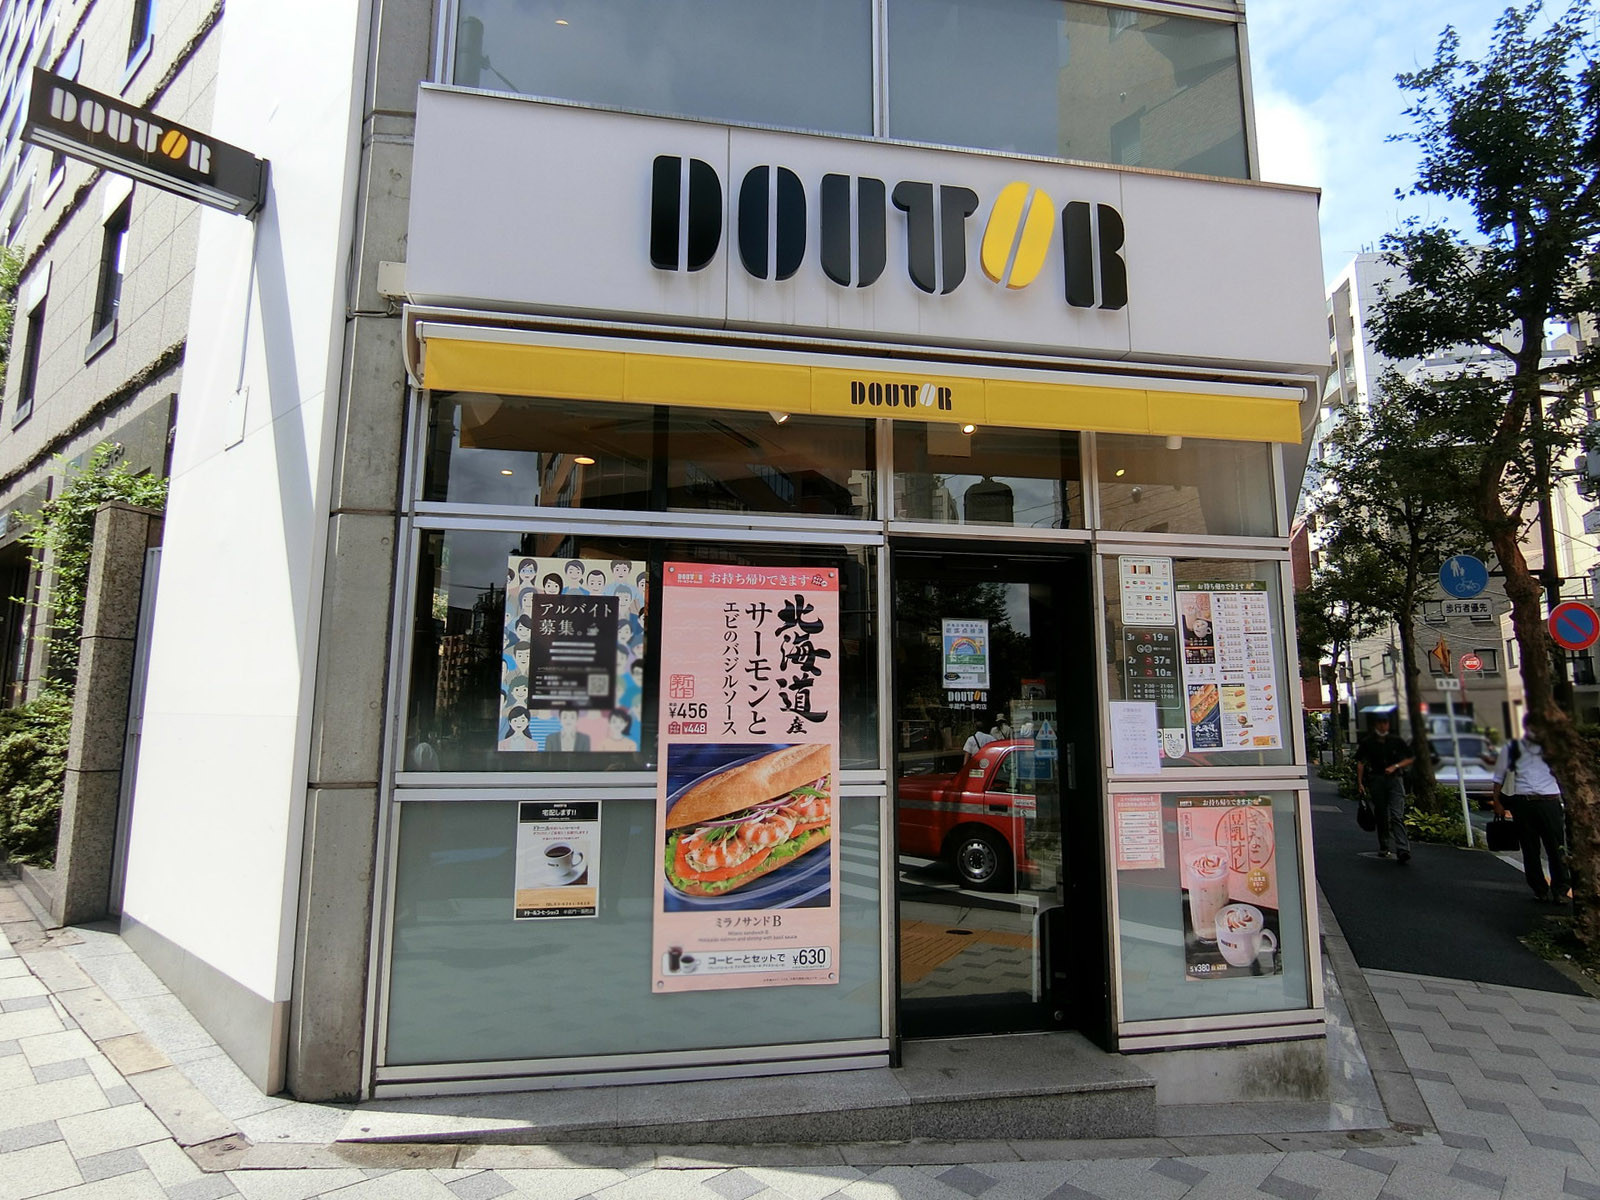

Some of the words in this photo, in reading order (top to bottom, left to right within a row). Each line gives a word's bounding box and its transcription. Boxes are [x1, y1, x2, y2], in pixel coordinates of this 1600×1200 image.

[51, 87, 212, 174] DOUTOR
[649, 155, 1128, 310] DOUTOR
[850, 380, 952, 411] DOUTOR
[709, 572, 810, 587] お持ち帰りできます
[540, 602, 613, 618] アルバイト
[1445, 603, 1488, 613] 歩行者優先
[722, 602, 740, 735] エビのバジルソース
[744, 602, 773, 735] サーモンと
[774, 593, 832, 735] 北海道産
[668, 702, 708, 719] ¥456
[947, 690, 988, 702] DOUTOR
[1231, 810, 1246, 870] 豆乳オレ
[708, 953, 786, 965] コーヒーとセットで
[792, 948, 826, 965] ¥630
